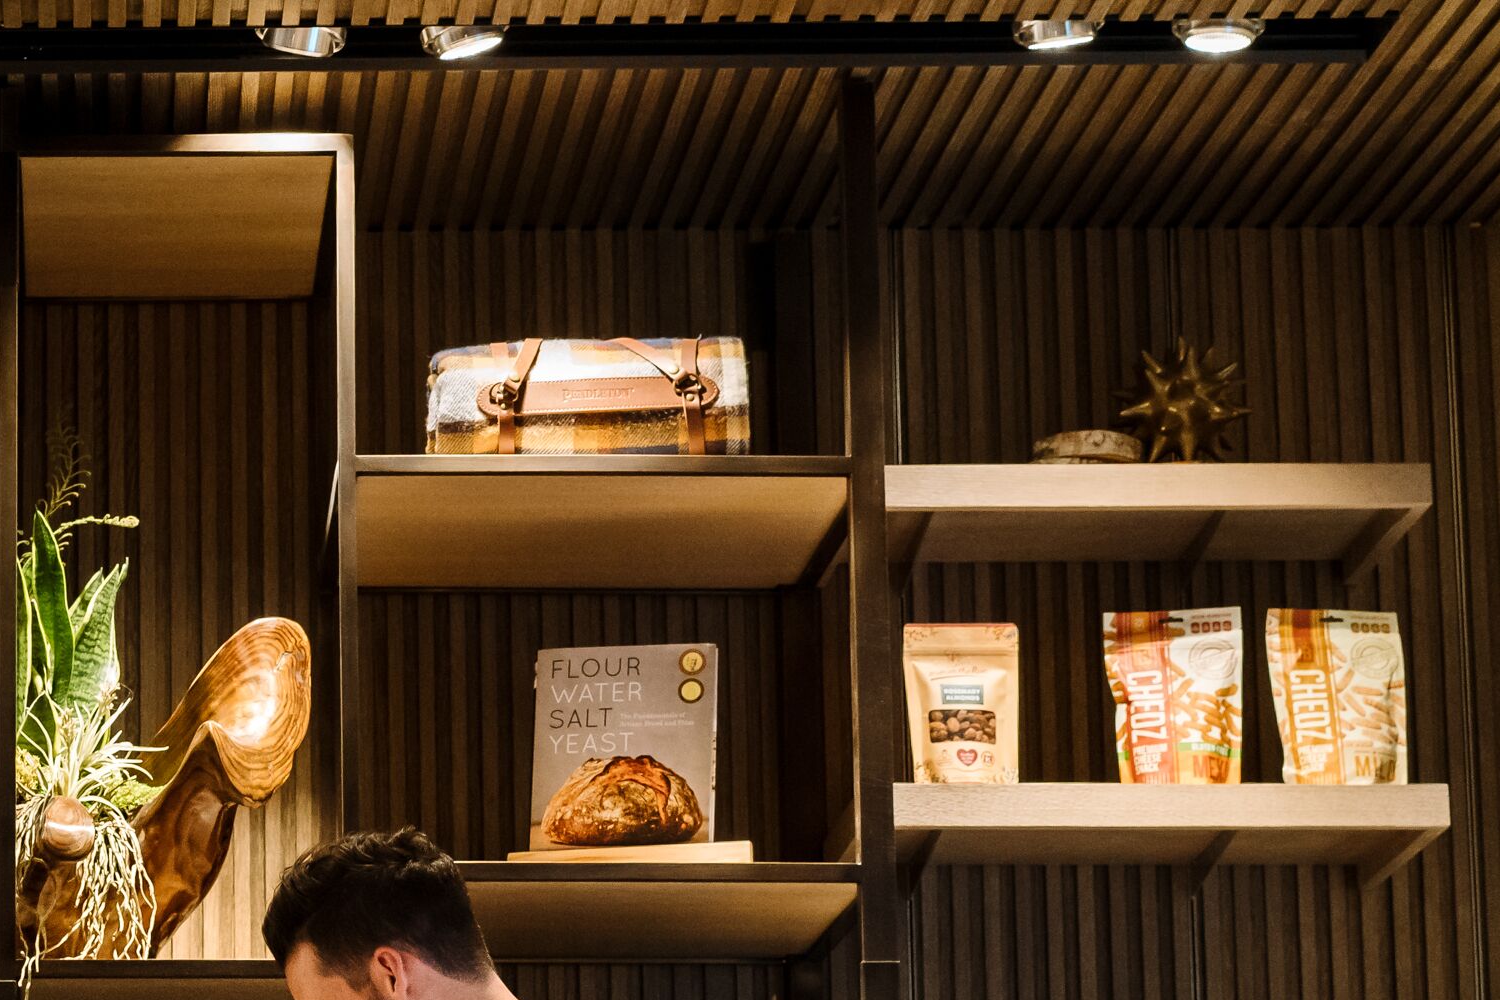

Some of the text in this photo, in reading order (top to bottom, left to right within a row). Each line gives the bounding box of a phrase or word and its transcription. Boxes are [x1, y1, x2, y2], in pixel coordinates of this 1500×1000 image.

[551, 657, 641, 679] FLOUR
[550, 681, 642, 703] WATER
[1126, 670, 1168, 743] CHEDZ
[1289, 669, 1333, 743] CHEDZ
[549, 707, 613, 729] SALT
[550, 732, 634, 754] YEAST
